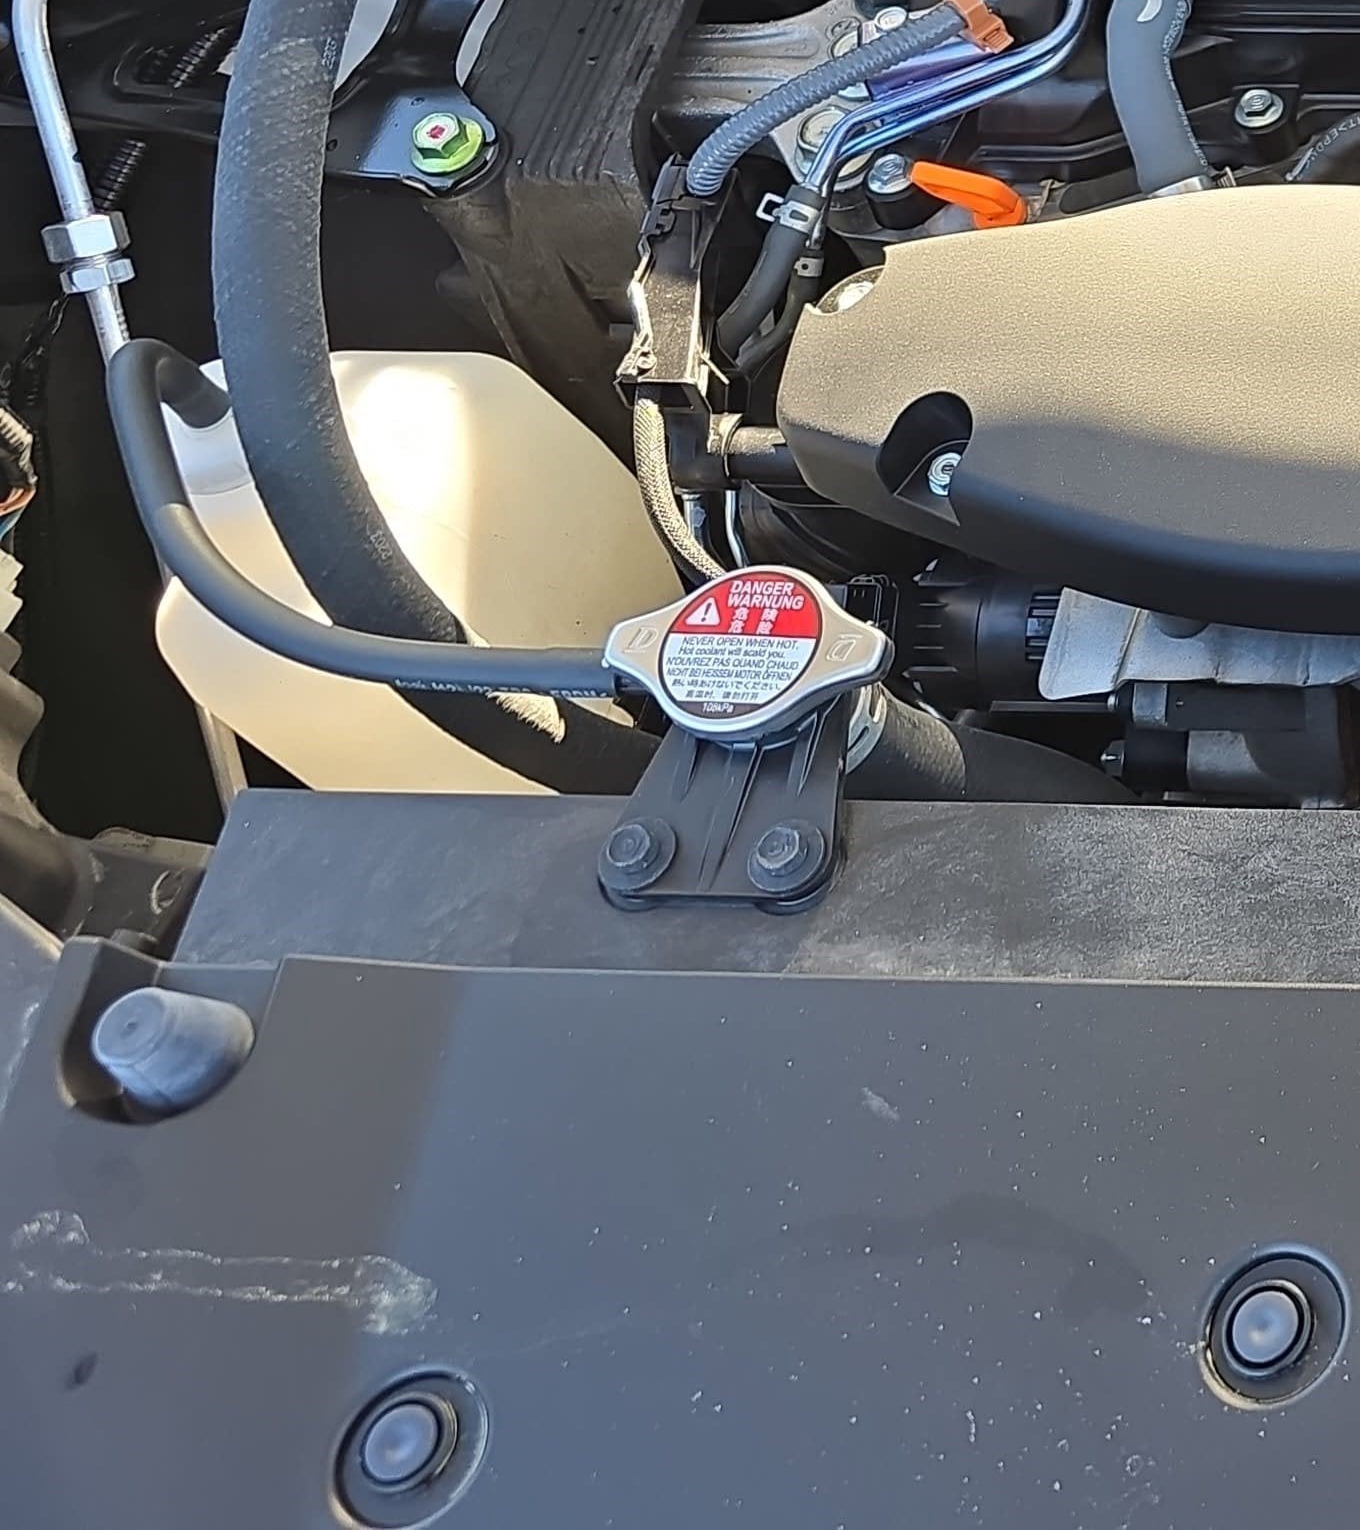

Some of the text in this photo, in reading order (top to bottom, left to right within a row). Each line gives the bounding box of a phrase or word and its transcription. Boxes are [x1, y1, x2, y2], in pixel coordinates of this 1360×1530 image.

[730, 581, 793, 595] DANGER
[728, 594, 804, 609] WARNUNG
[682, 637, 799, 650] NEVER OPEN WHEN HOT.
[679, 647, 694, 655] Hot
[696, 648, 726, 656] coolant
[728, 648, 742, 656] will
[743, 648, 766, 657] scald
[713, 658, 730, 667] PAS
[733, 659, 764, 669] QUAND
[766, 661, 799, 670] CHAUD
[702, 703, 734, 713] 108kPa
